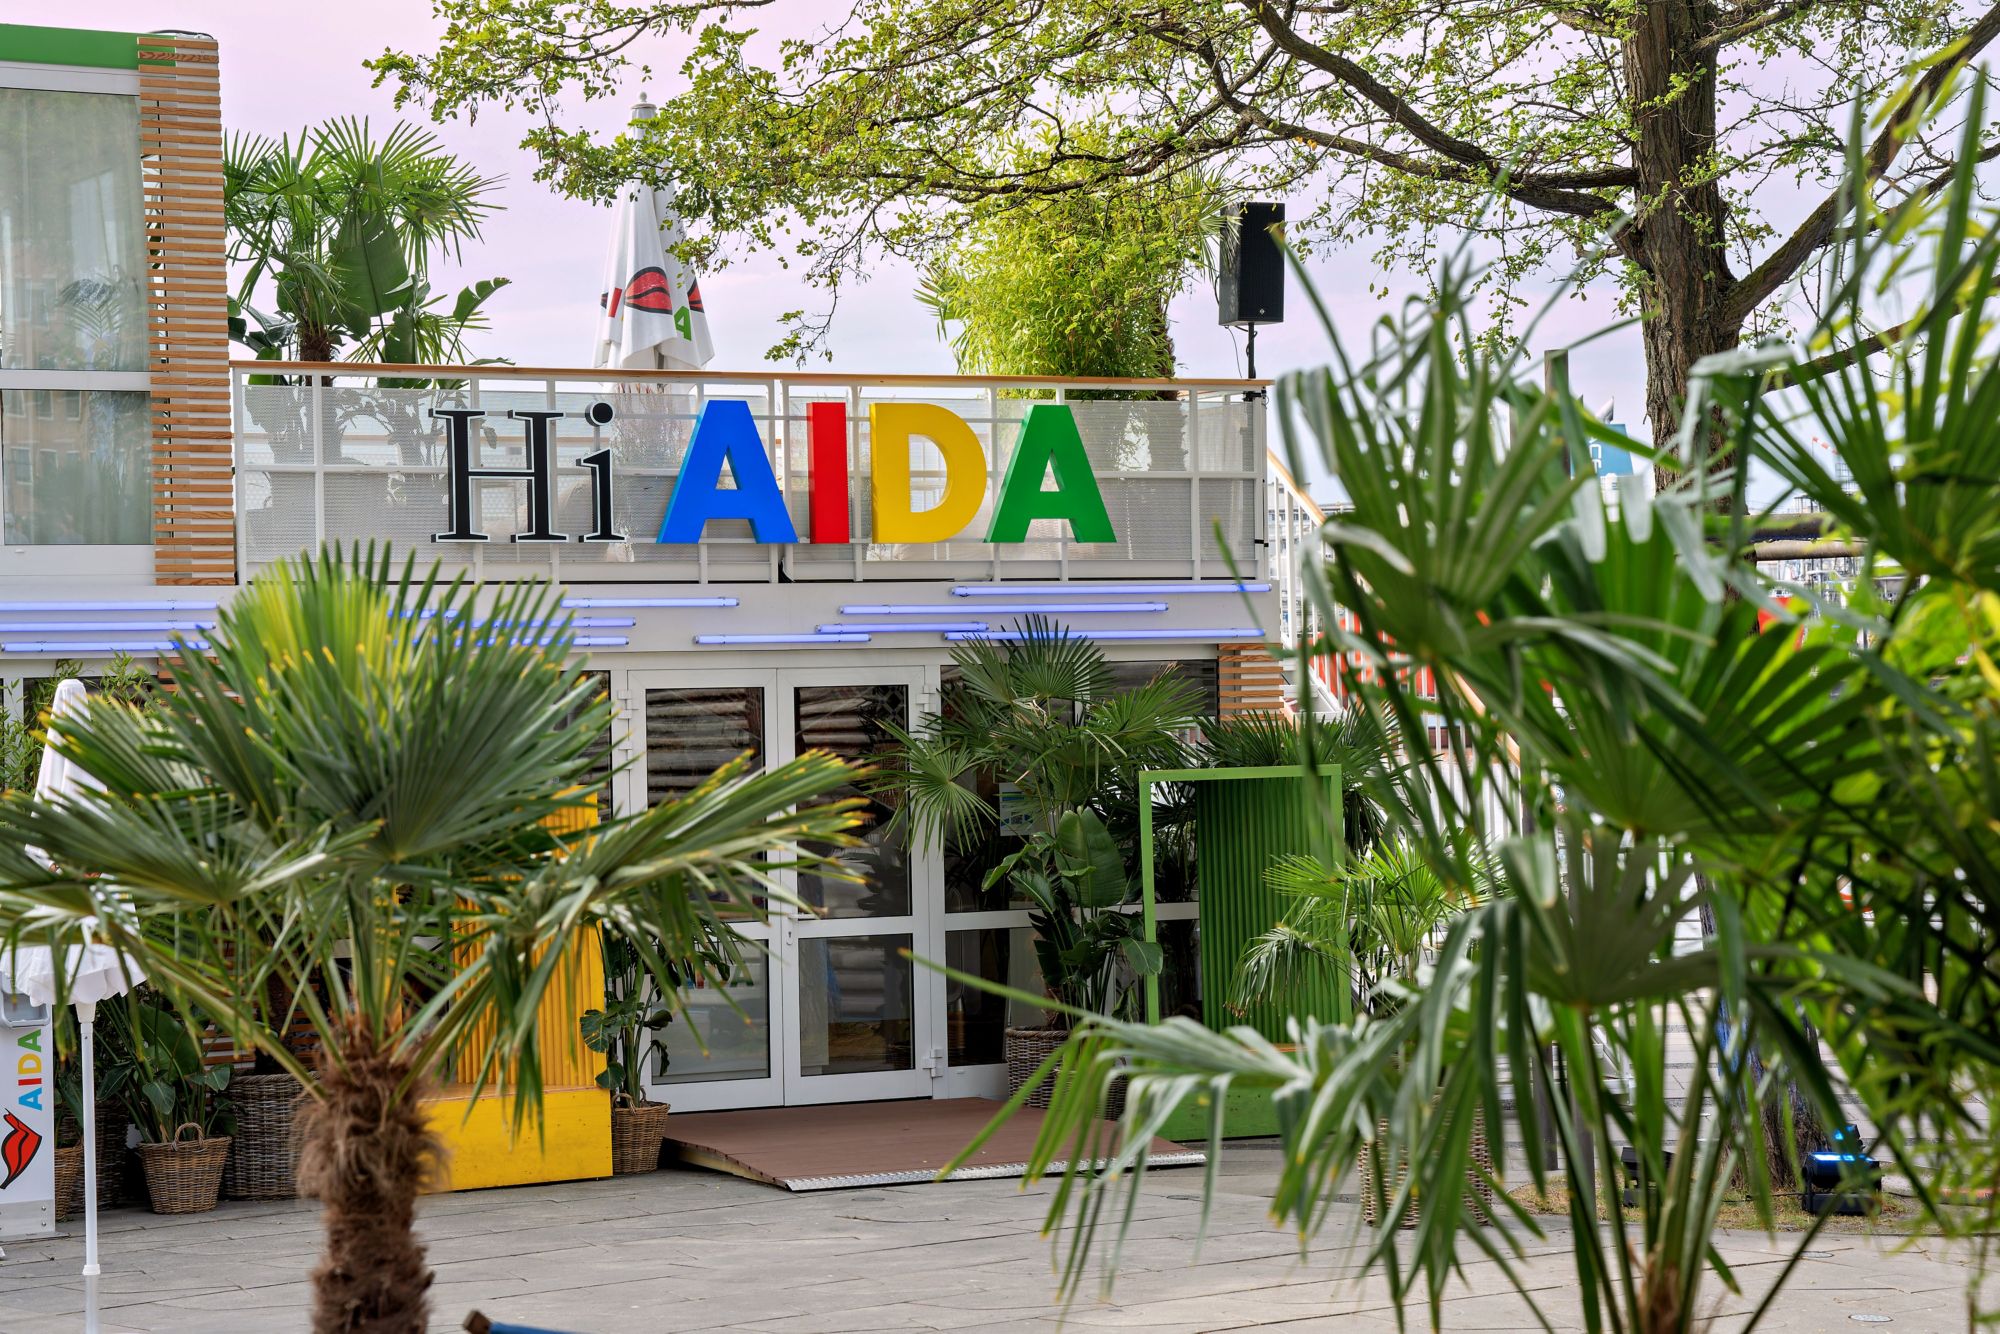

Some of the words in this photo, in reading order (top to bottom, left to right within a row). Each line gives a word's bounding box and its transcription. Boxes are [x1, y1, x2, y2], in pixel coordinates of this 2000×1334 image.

[428, 401, 628, 544] Hi
[655, 400, 1117, 544] AIDA
[17, 1029, 43, 1111] AIDA
